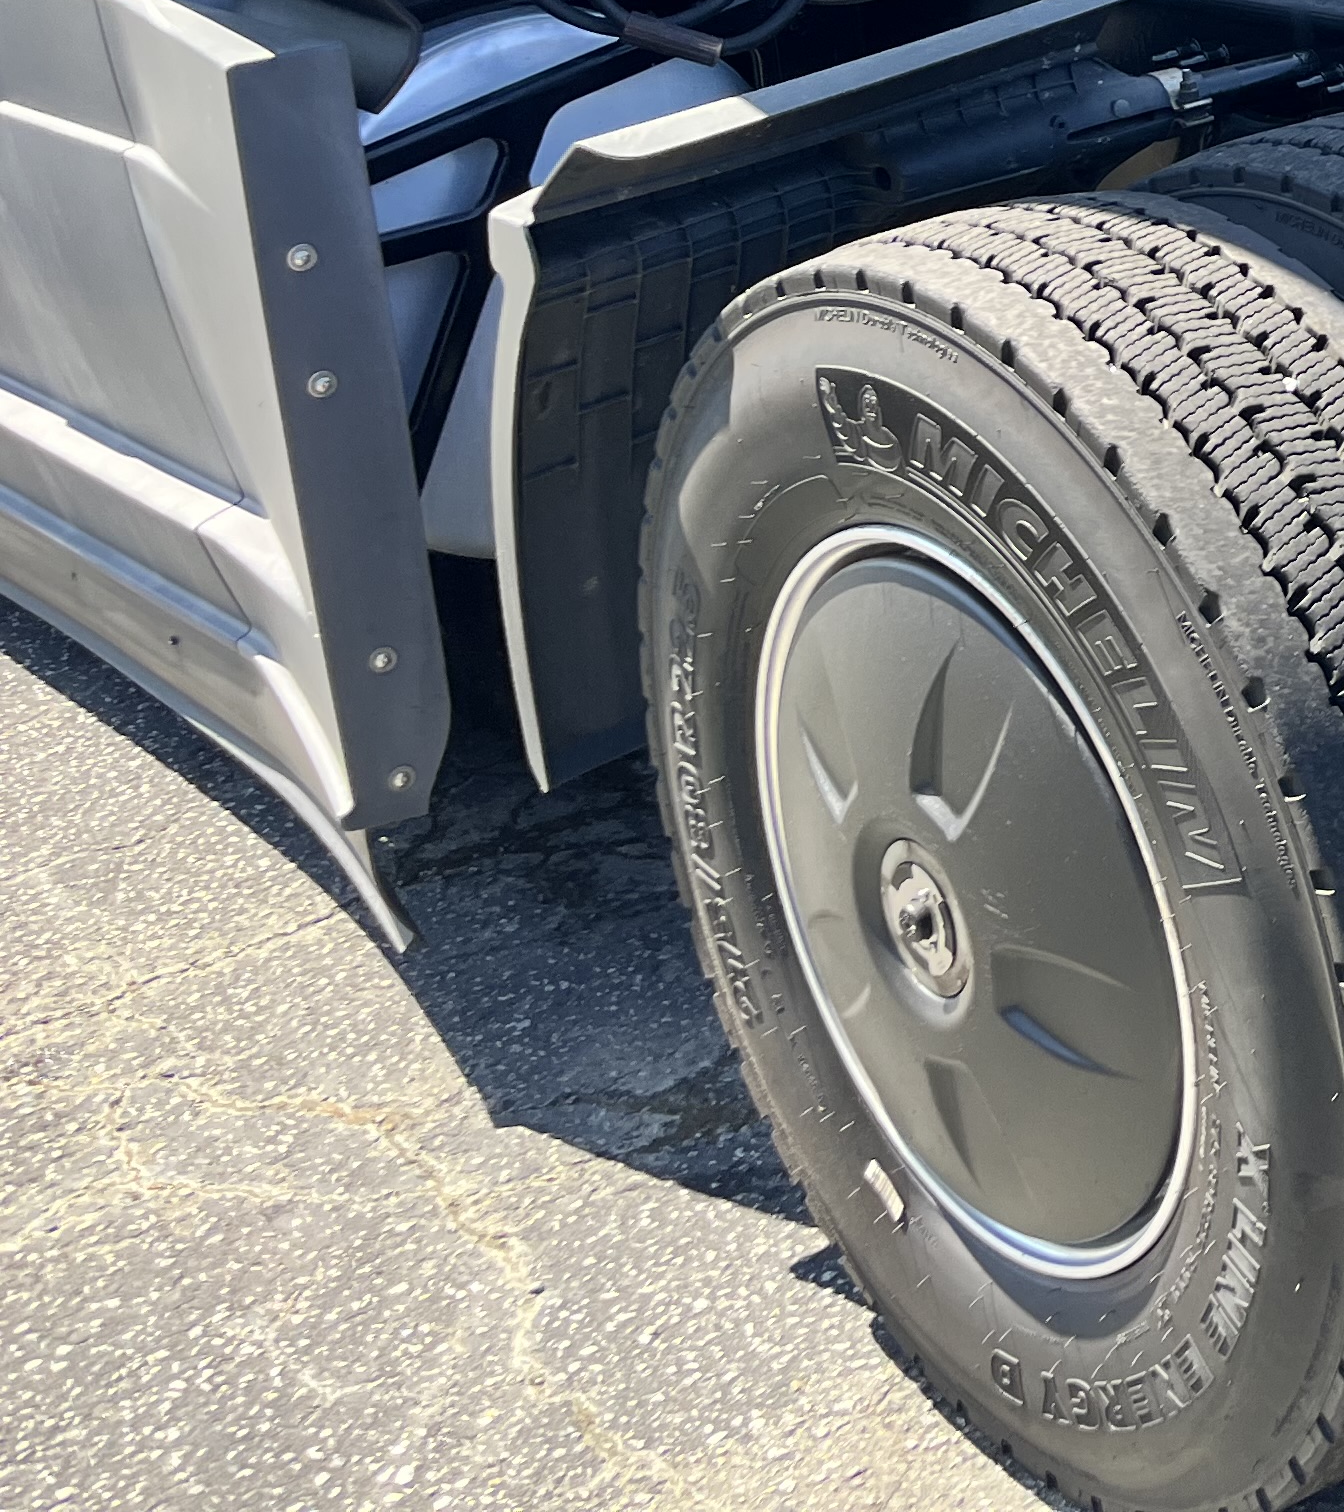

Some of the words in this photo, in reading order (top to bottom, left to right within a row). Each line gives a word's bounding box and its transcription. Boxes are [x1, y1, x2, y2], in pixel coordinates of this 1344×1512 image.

[908, 412, 1225, 869] MICHELIN
[1200, 1197, 1267, 1359] LINE
[990, 1348, 1025, 1405] D
[1040, 1334, 1215, 1431] ENERGY
